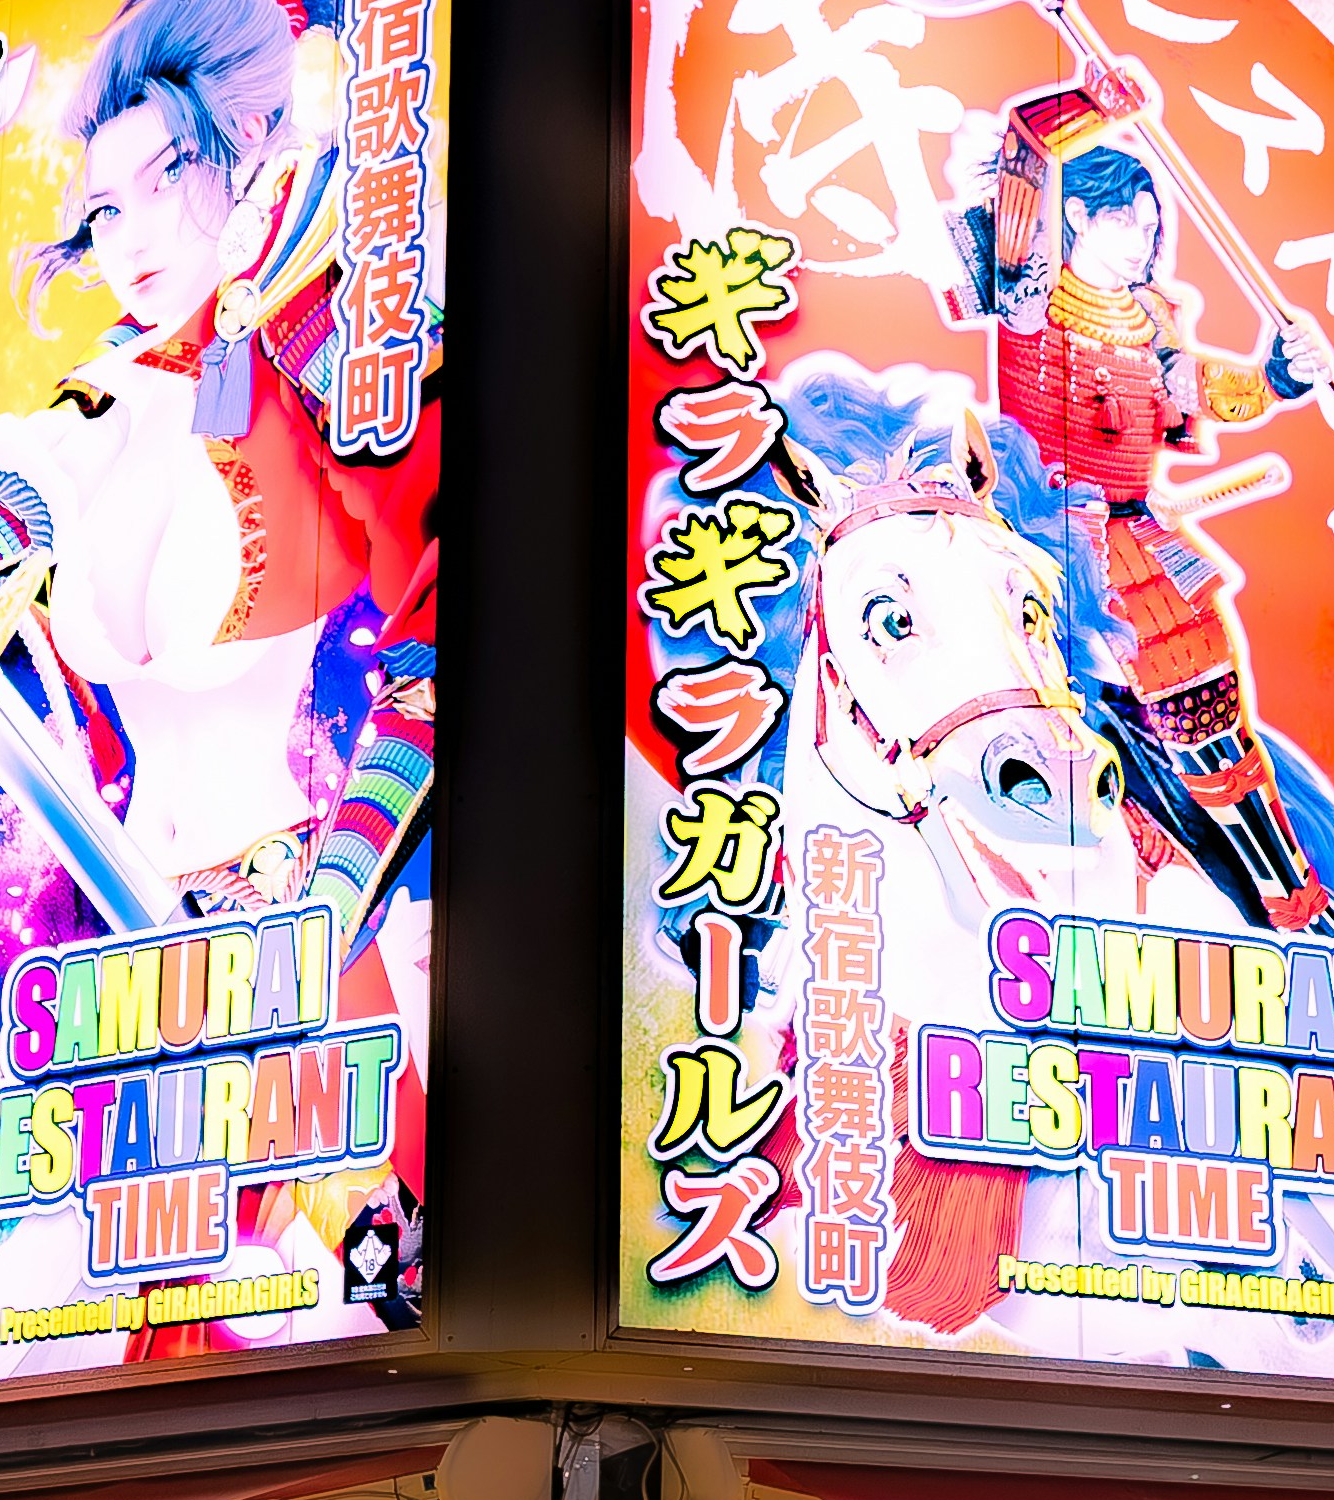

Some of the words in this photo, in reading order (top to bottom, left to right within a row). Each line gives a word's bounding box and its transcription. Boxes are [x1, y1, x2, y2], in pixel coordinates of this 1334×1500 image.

[644, 228, 799, 1297] ギラギラガールズ
[10, 905, 338, 1076] SAMURAI
[800, 823, 888, 1312] 新宿歌舞伎町
[86, 1165, 233, 1280] TIME
[1100, 1150, 1283, 1256] TIME
[0, 1297, 114, 1345] Presented
[147, 1269, 318, 1329] GIRAGIRAGIRLS
[998, 1253, 1138, 1306] Presented
